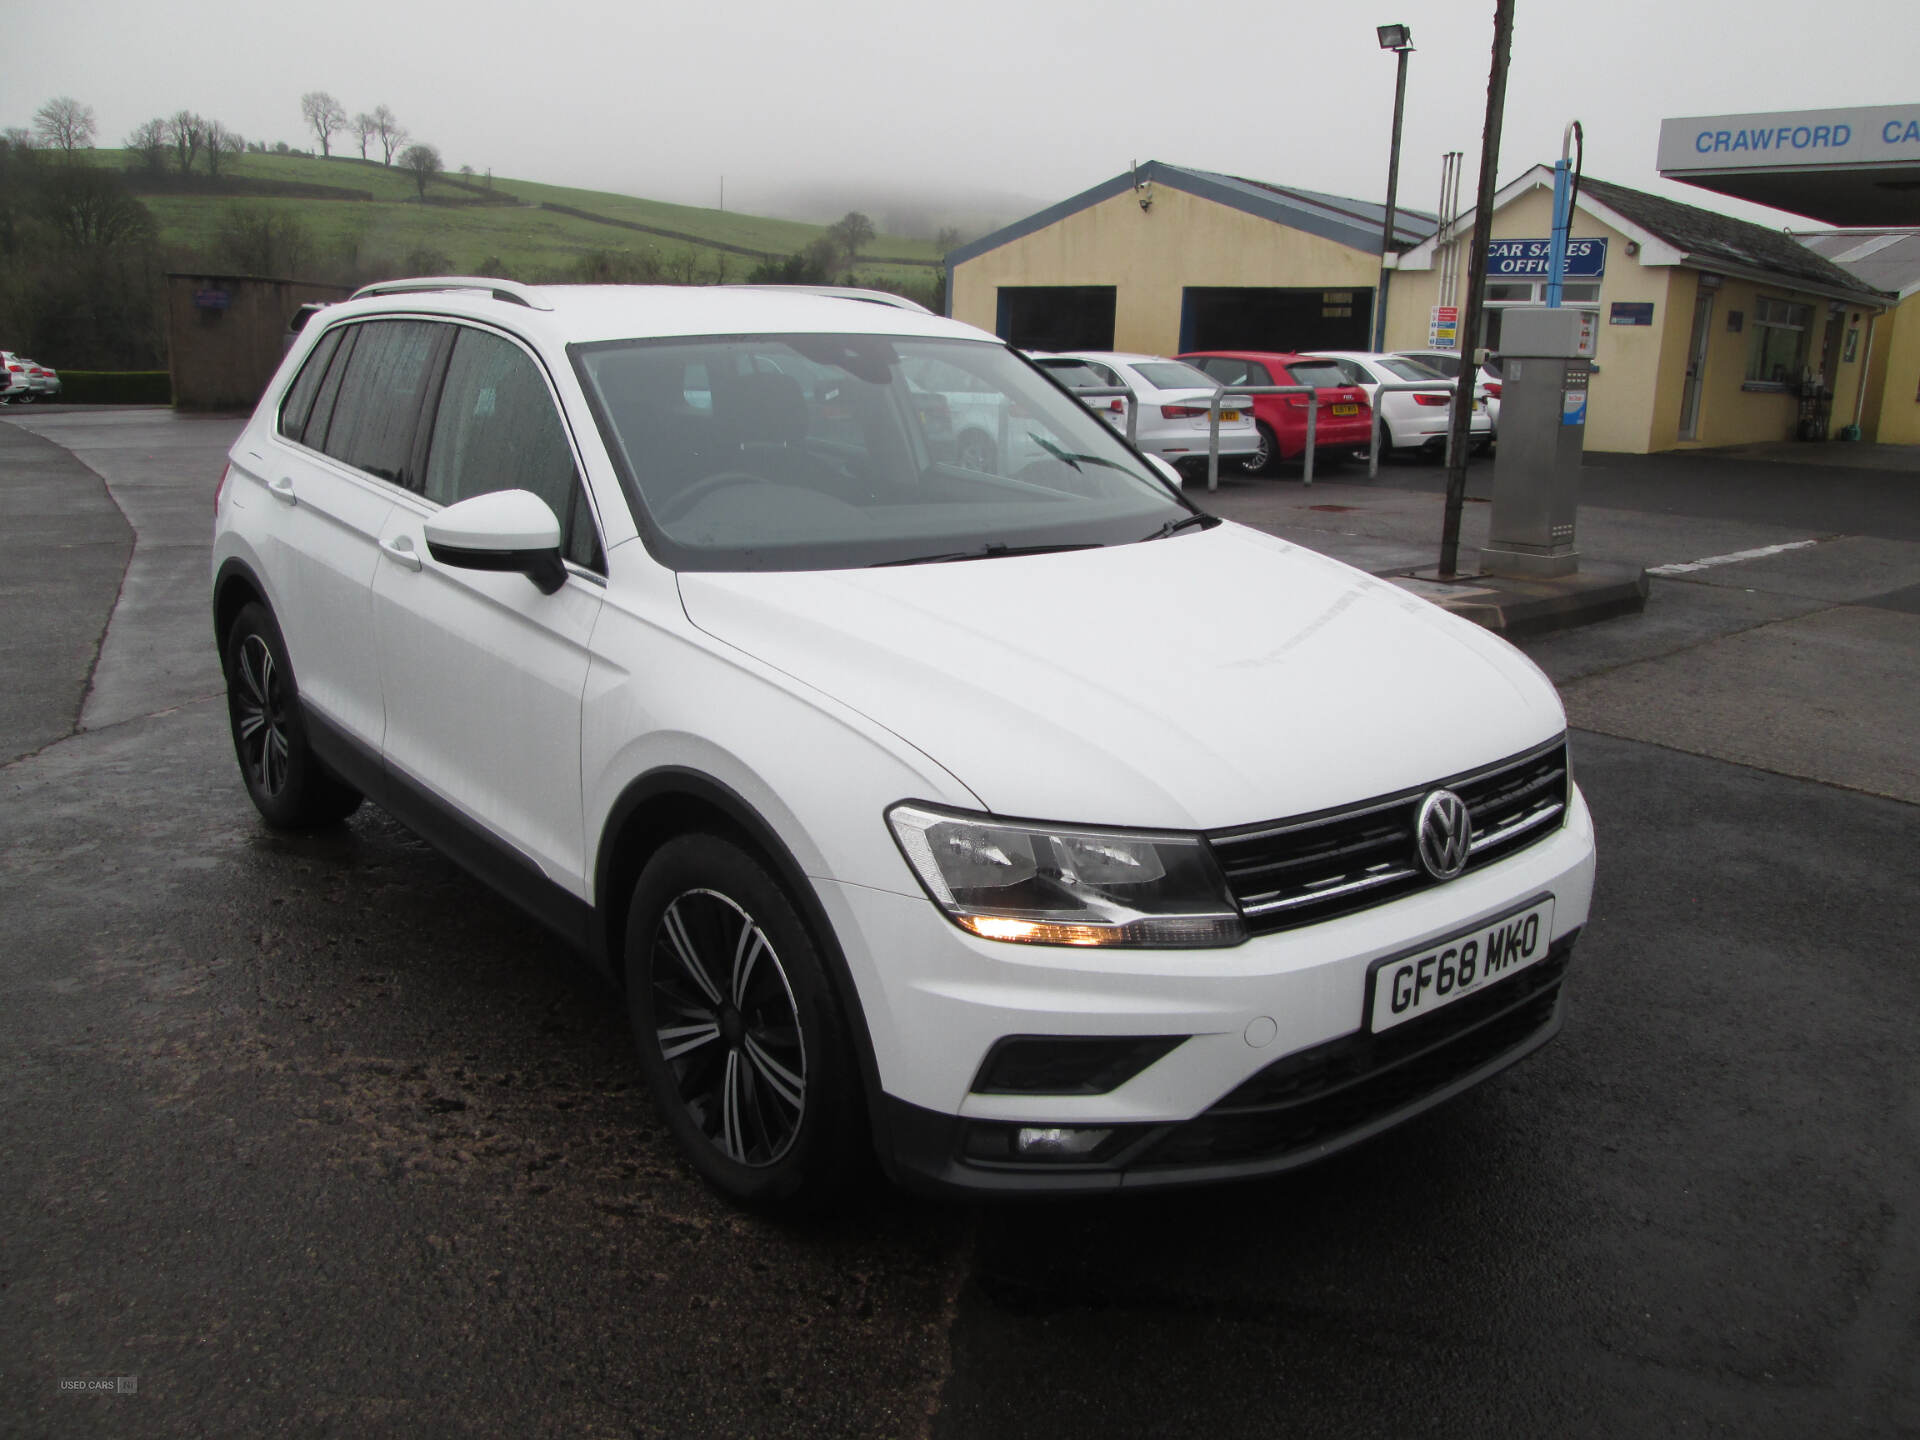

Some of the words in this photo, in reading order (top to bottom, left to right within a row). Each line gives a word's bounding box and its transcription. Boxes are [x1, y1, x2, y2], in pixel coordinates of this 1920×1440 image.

[1695, 124, 1852, 153] CRAWFORD
[1881, 120, 1920, 144] CA
[1487, 244, 1523, 257] CAR
[1528, 243, 1592, 257] SAES
[1391, 940, 1478, 1014] GF68
[1484, 912, 1539, 977] MKO
